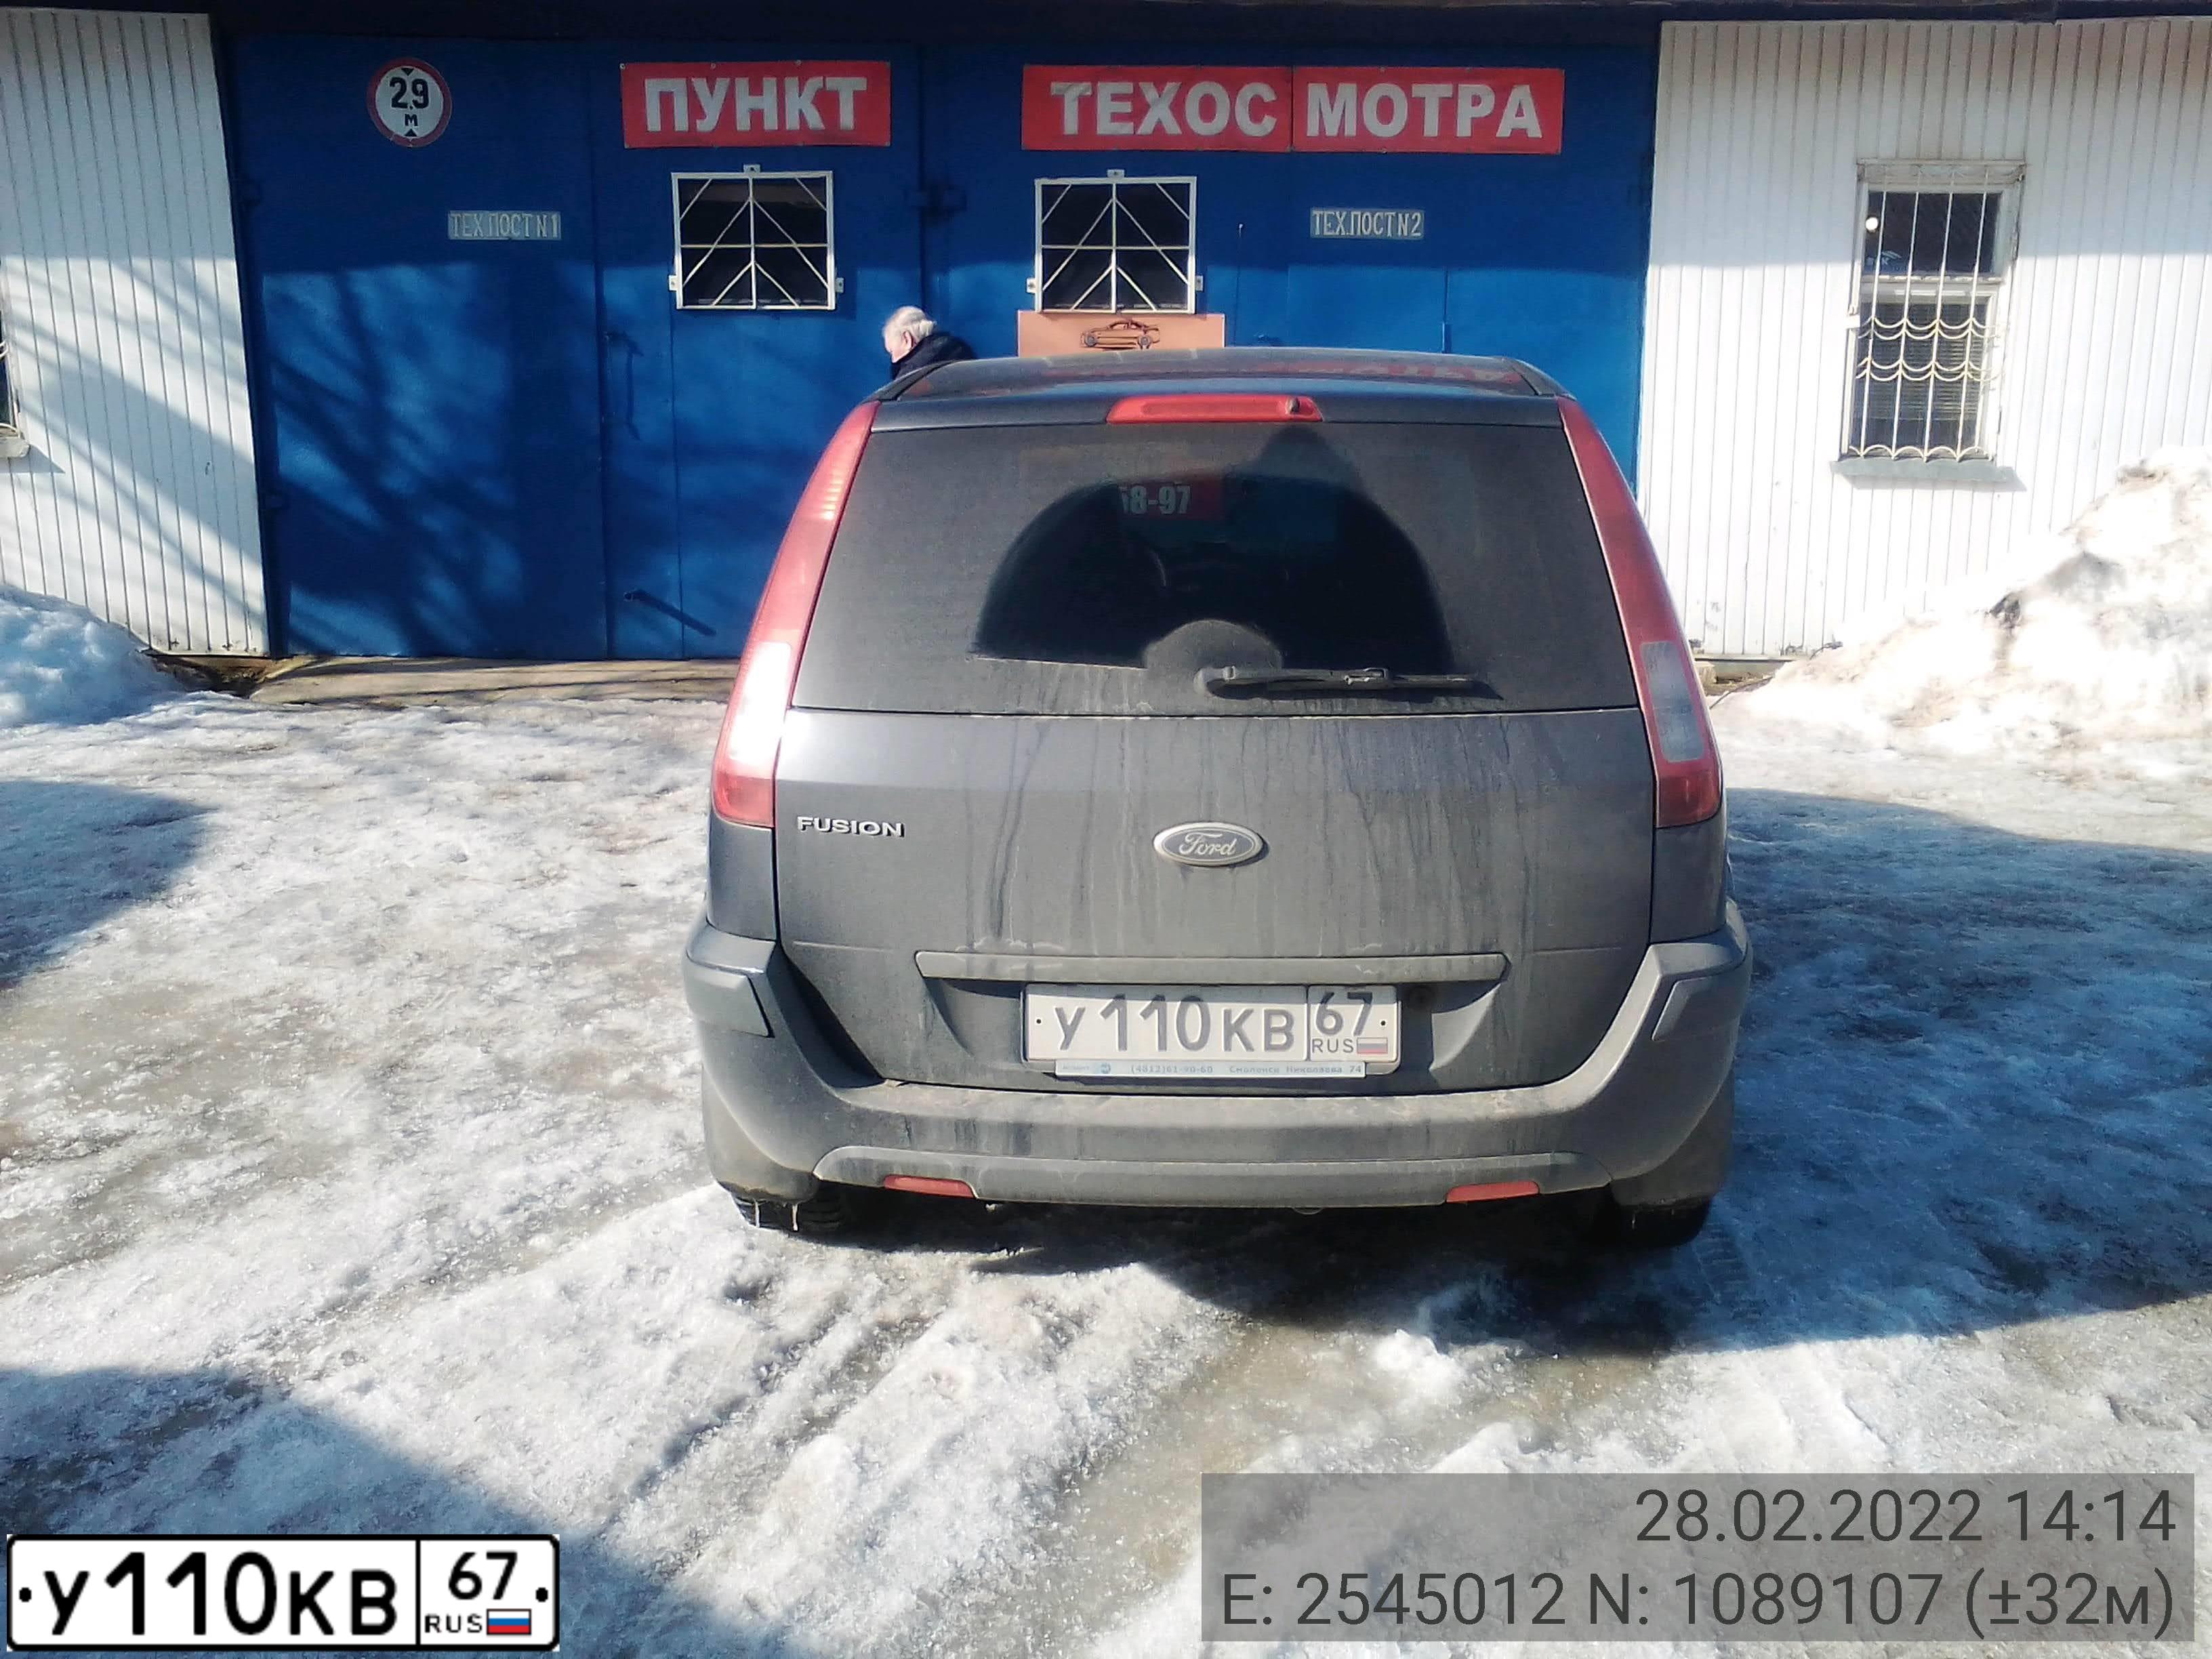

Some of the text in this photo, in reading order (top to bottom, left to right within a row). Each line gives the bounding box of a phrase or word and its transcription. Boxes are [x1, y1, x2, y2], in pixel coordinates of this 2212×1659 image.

[644, 76, 1542, 138] ПУНКТ ТЕХОС МОТРА
[796, 815, 905, 838] FUSION
[1179, 831, 1237, 856] Ford
[1054, 991, 1373, 1052] У110КВ 67
[1311, 1038, 1355, 1054] RUS
[1349, 1064, 1361, 1073] 74
